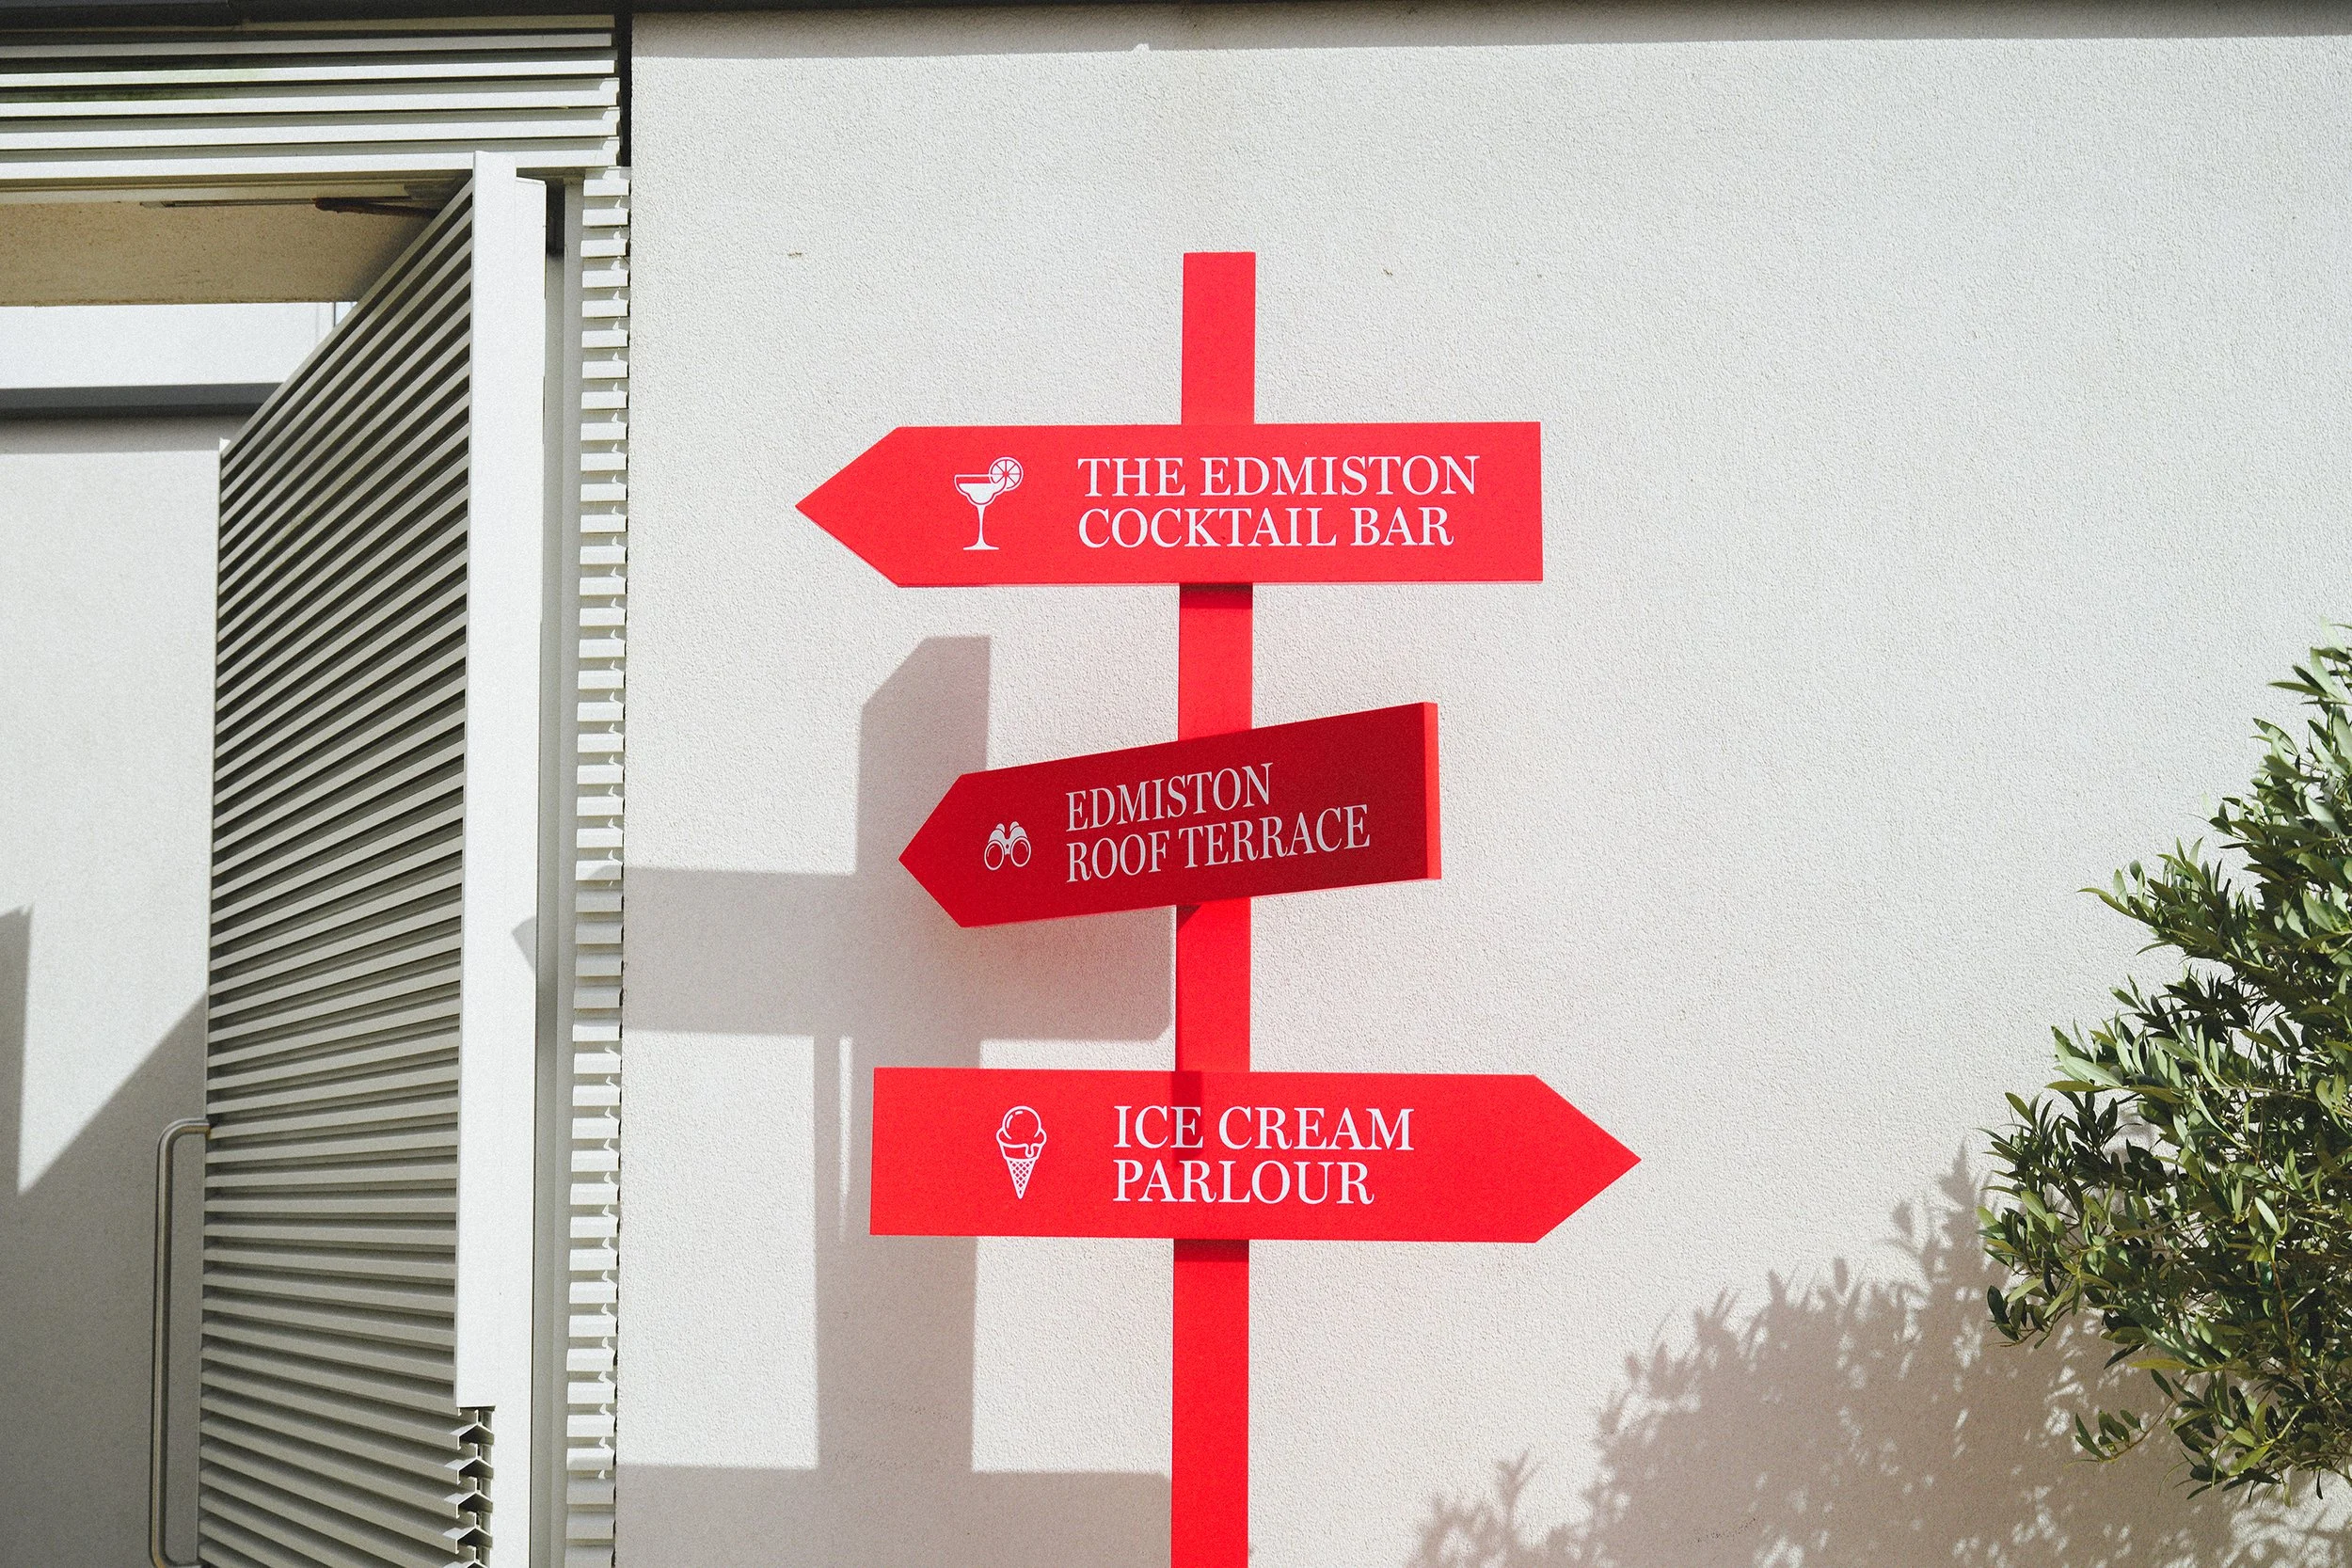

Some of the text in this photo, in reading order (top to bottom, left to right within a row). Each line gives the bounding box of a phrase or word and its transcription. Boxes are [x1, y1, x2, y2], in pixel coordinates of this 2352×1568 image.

[1077, 455, 1481, 498] THE EDMISTON
[1077, 506, 1454, 548] COCKTAIL BAR
[1065, 762, 1274, 832] EDMISTON
[1066, 803, 1371, 883] ROOF TERRACE
[1113, 1105, 1415, 1151] ICE CREAM
[1112, 1159, 1375, 1205] PARLOUR
